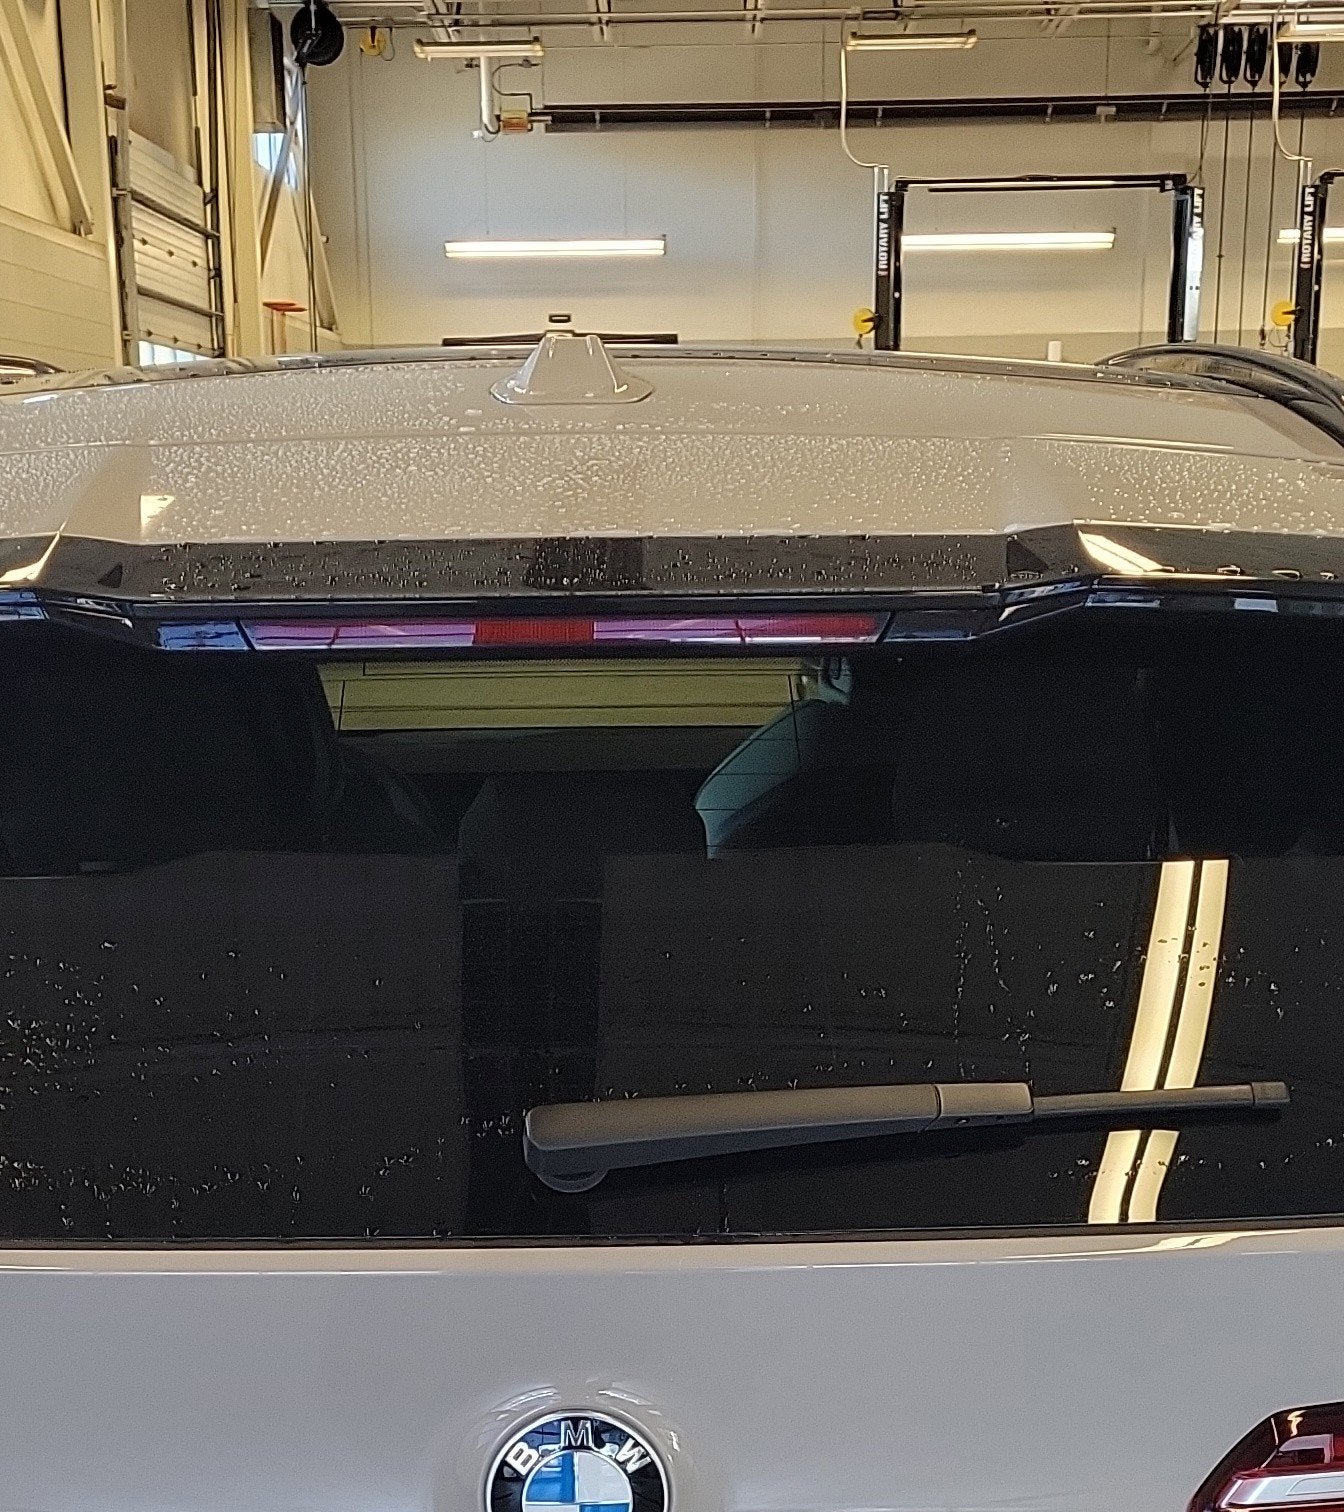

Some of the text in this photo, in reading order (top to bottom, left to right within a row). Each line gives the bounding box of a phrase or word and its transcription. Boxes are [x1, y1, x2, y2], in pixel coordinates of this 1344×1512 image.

[878, 193, 890, 269] ROTARY LIFT
[1301, 186, 1316, 263] ROTARY LIFT
[505, 1419, 652, 1477] BMW
